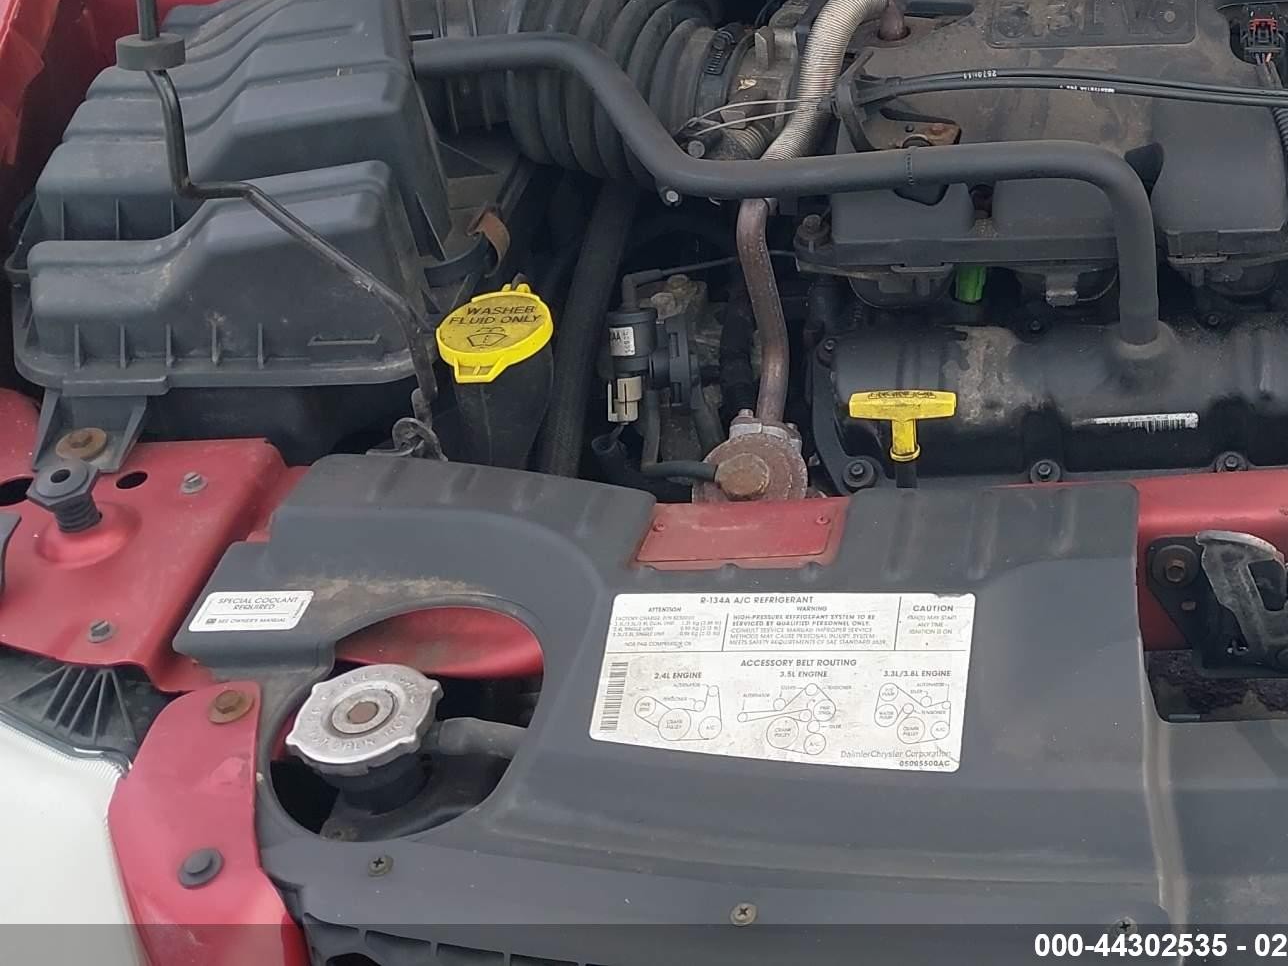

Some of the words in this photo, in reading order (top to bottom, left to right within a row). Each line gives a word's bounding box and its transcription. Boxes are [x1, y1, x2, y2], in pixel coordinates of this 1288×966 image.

[466, 305, 537, 316] WASHER
[449, 316, 496, 326] FLUID
[500, 314, 542, 324] ONLY
[254, 596, 299, 604] COOLANT
[700, 596, 731, 605] R-134A
[733, 596, 751, 605] A/C
[753, 595, 814, 605] REFRIGERANT
[912, 604, 954, 612] CAUTION
[740, 659, 794, 667] ACCESSORY
[816, 658, 857, 666] ROUTING
[654, 672, 671, 680] 2.4L
[672, 671, 702, 679] ENGINE
[779, 670, 796, 678] 3.5L
[797, 670, 828, 678] ENGINE
[840, 750, 903, 760] DaimlerChrysler
[904, 750, 952, 759] Corporation
